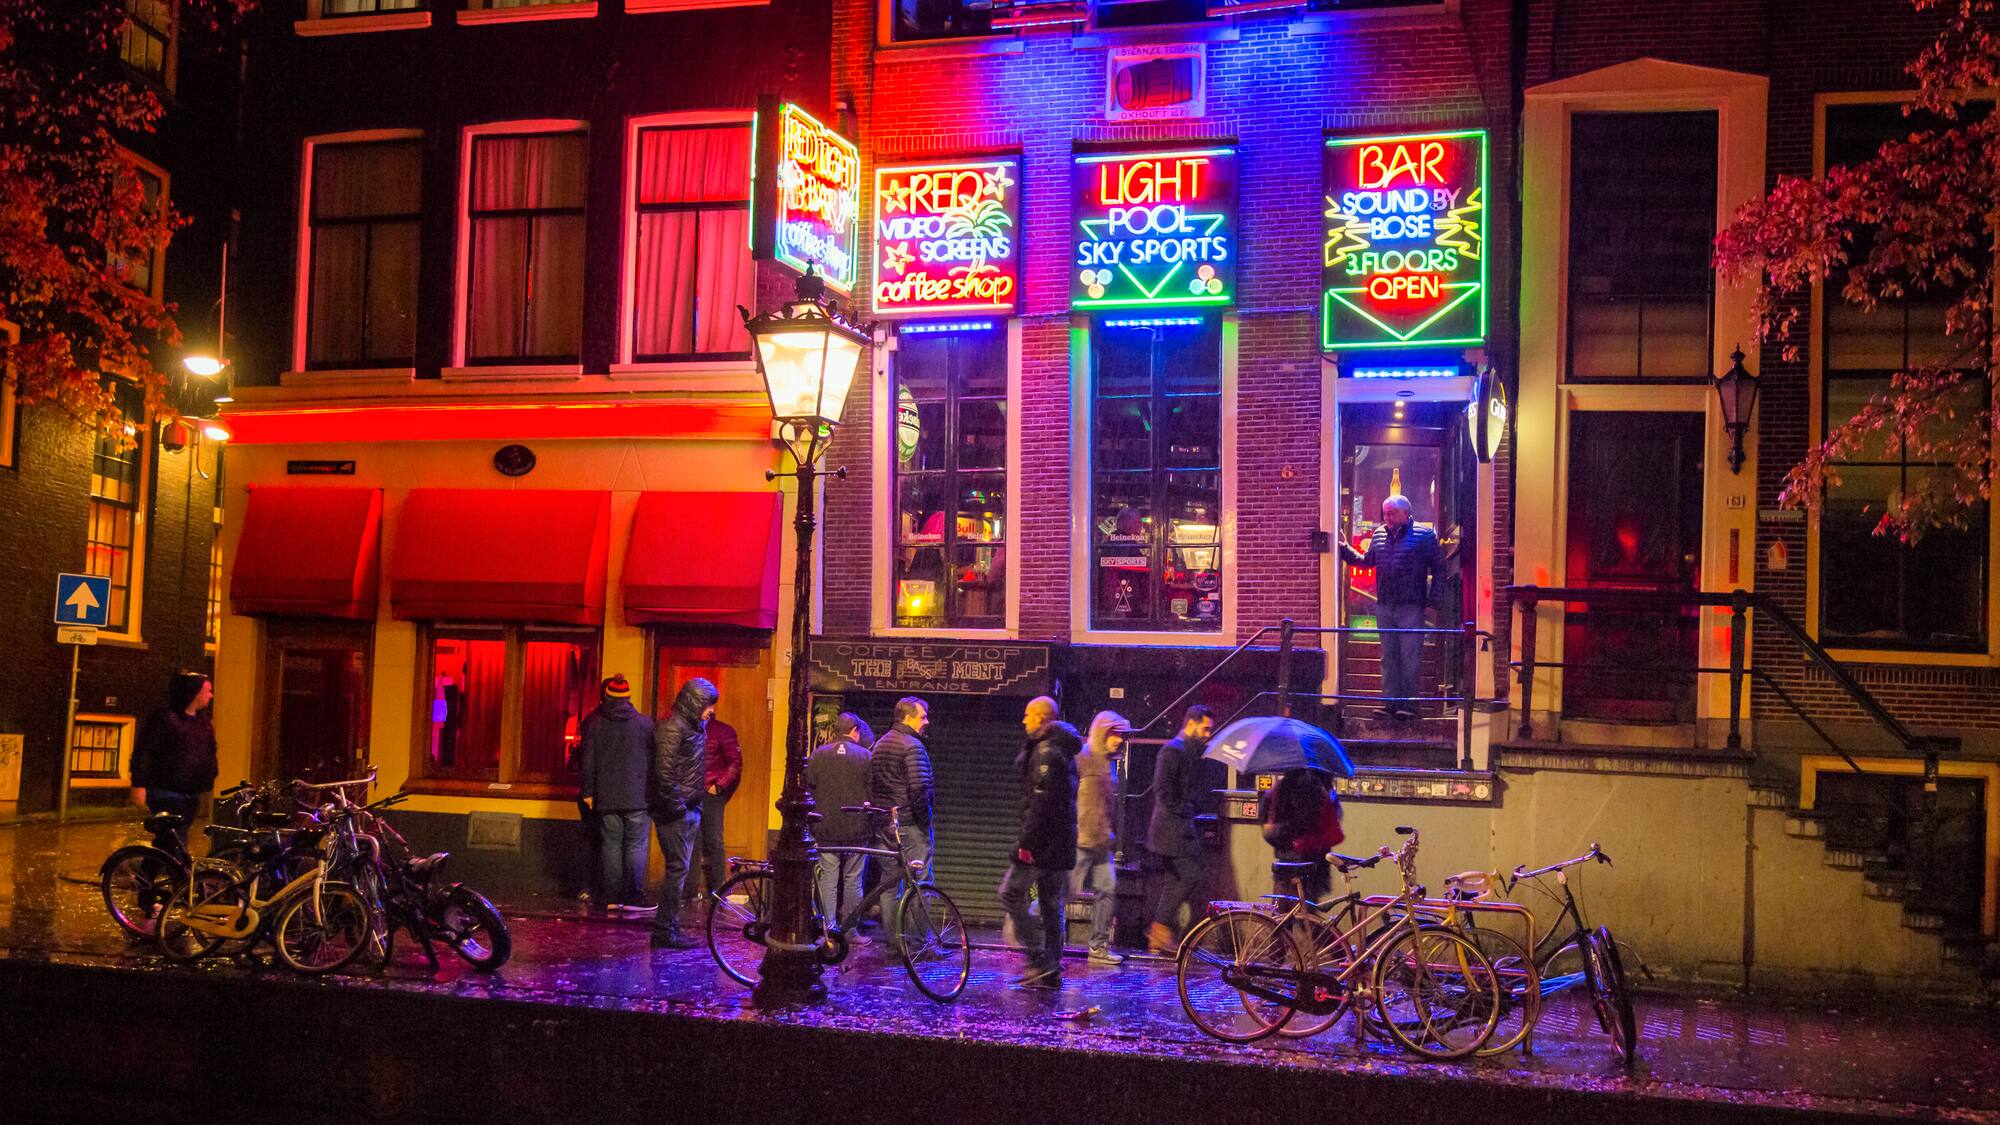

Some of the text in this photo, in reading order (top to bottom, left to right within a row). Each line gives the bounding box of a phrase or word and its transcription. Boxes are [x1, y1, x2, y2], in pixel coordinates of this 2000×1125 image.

[787, 117, 856, 192] RED LIGHT
[1358, 142, 1449, 189] BAR
[910, 170, 983, 214] RED
[1101, 158, 1209, 205] LIGHT
[1342, 187, 1462, 216] SOUND BY
[880, 215, 947, 240] VIDEO
[1109, 204, 1195, 236] POOL
[1371, 214, 1431, 240] BOSE
[920, 236, 1011, 262] SCREENS
[1077, 236, 1228, 265] SKY SPORTS
[1361, 248, 1459, 275] FLOORS
[878, 272, 1013, 304] coffee shop
[1369, 275, 1440, 300] OPEN
[1117, 557, 1146, 565] SPORTS
[836, 644, 1020, 660] COFFEE SHOP
[851, 659, 891, 677] THE
[952, 662, 1006, 680] MENT
[875, 680, 971, 692] ENTRANCE
